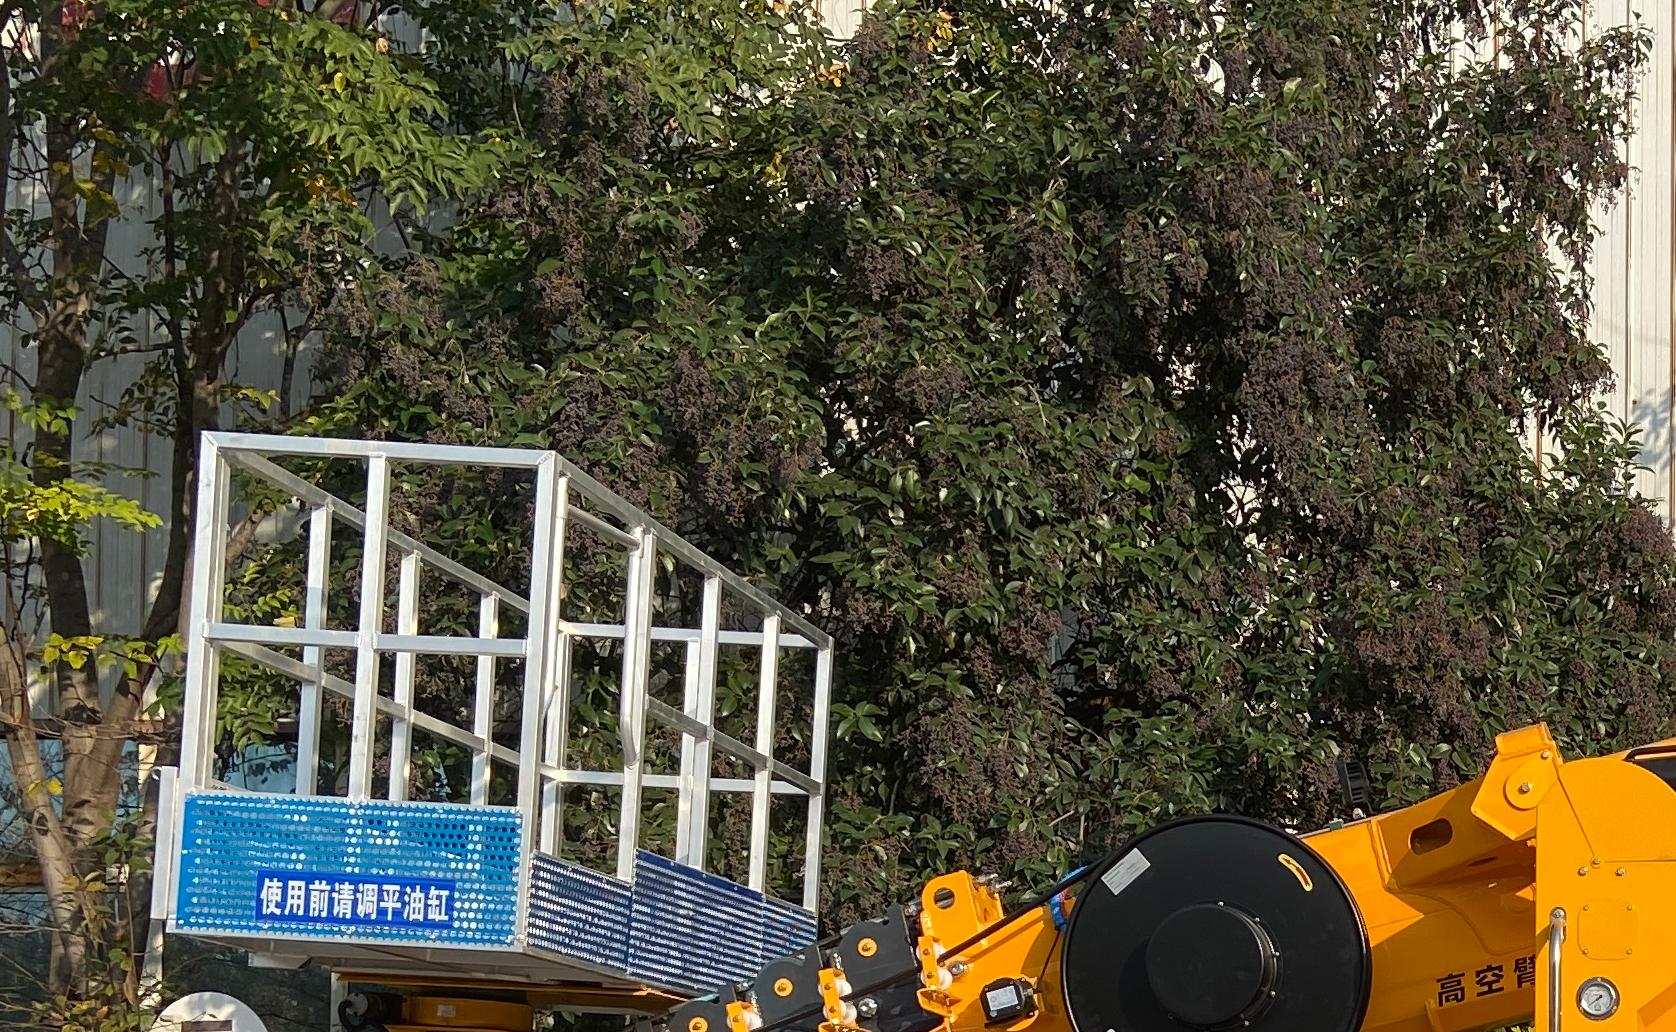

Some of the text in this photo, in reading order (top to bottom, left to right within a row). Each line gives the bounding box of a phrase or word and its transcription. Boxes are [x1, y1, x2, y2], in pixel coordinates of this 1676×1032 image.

[260, 877, 450, 922] 使用前请调平油缸
